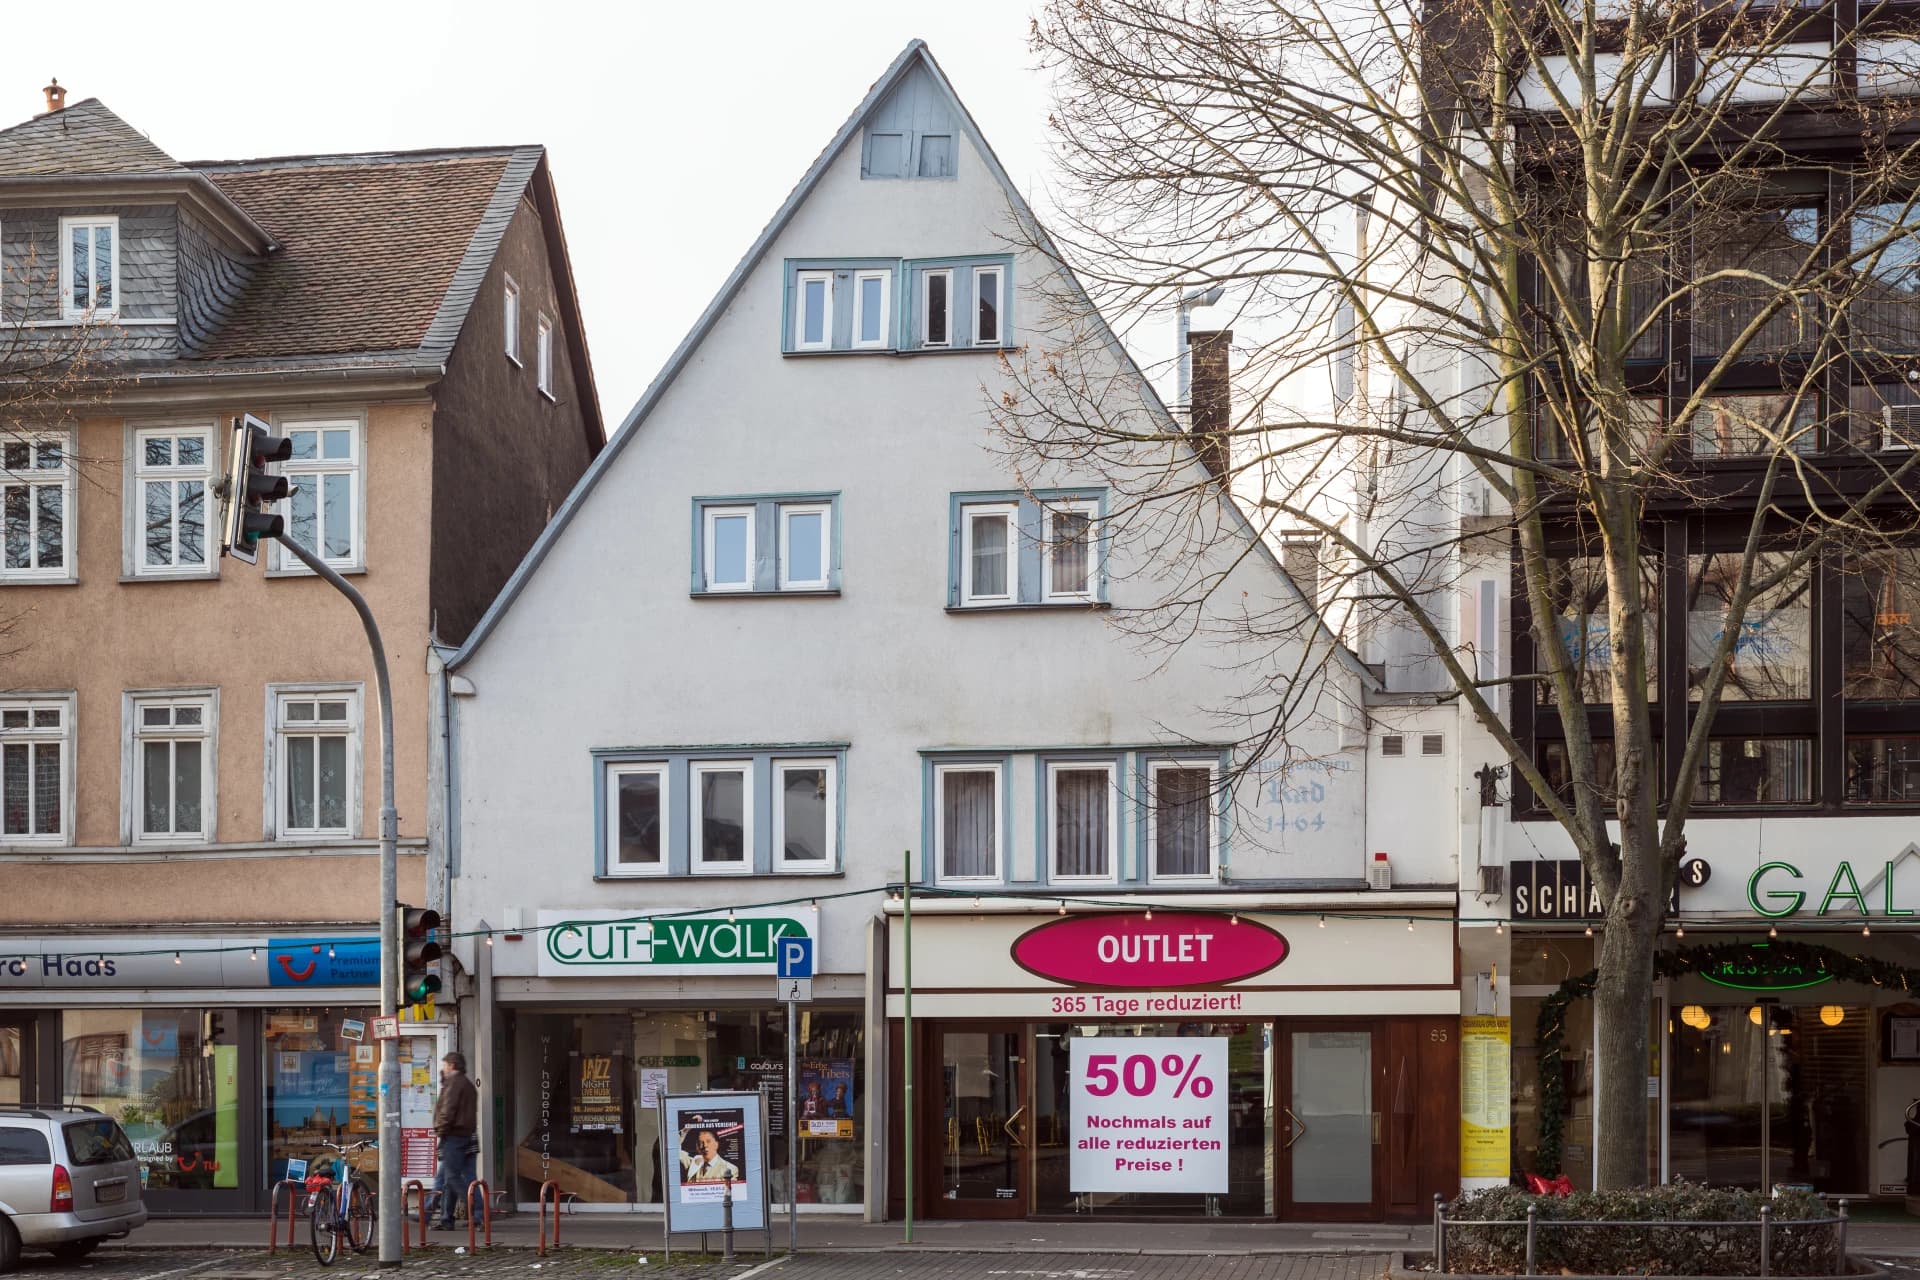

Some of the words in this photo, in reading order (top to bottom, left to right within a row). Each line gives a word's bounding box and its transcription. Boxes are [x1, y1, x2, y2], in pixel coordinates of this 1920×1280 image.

[1098, 934, 1213, 963] OUTLET
[43, 953, 117, 977] Haas
[785, 943, 805, 976] P
[331, 968, 375, 979] Partner
[1052, 996, 1086, 1013] 365
[1092, 995, 1139, 1015] Tage
[1146, 993, 1241, 1011] reduziert!
[581, 1056, 611, 1081] JAZZ
[1085, 1053, 1213, 1099] 50%
[582, 1080, 610, 1088] NIGHT
[1087, 1115, 1177, 1129] Nochmals
[1182, 1115, 1213, 1129] auf
[132, 1142, 172, 1153] RLAUB
[1078, 1136, 1110, 1150] alle
[1116, 1136, 1221, 1150] reduzierten
[1115, 1158, 1172, 1171] Preise
[1178, 1158, 1183, 1171] !
